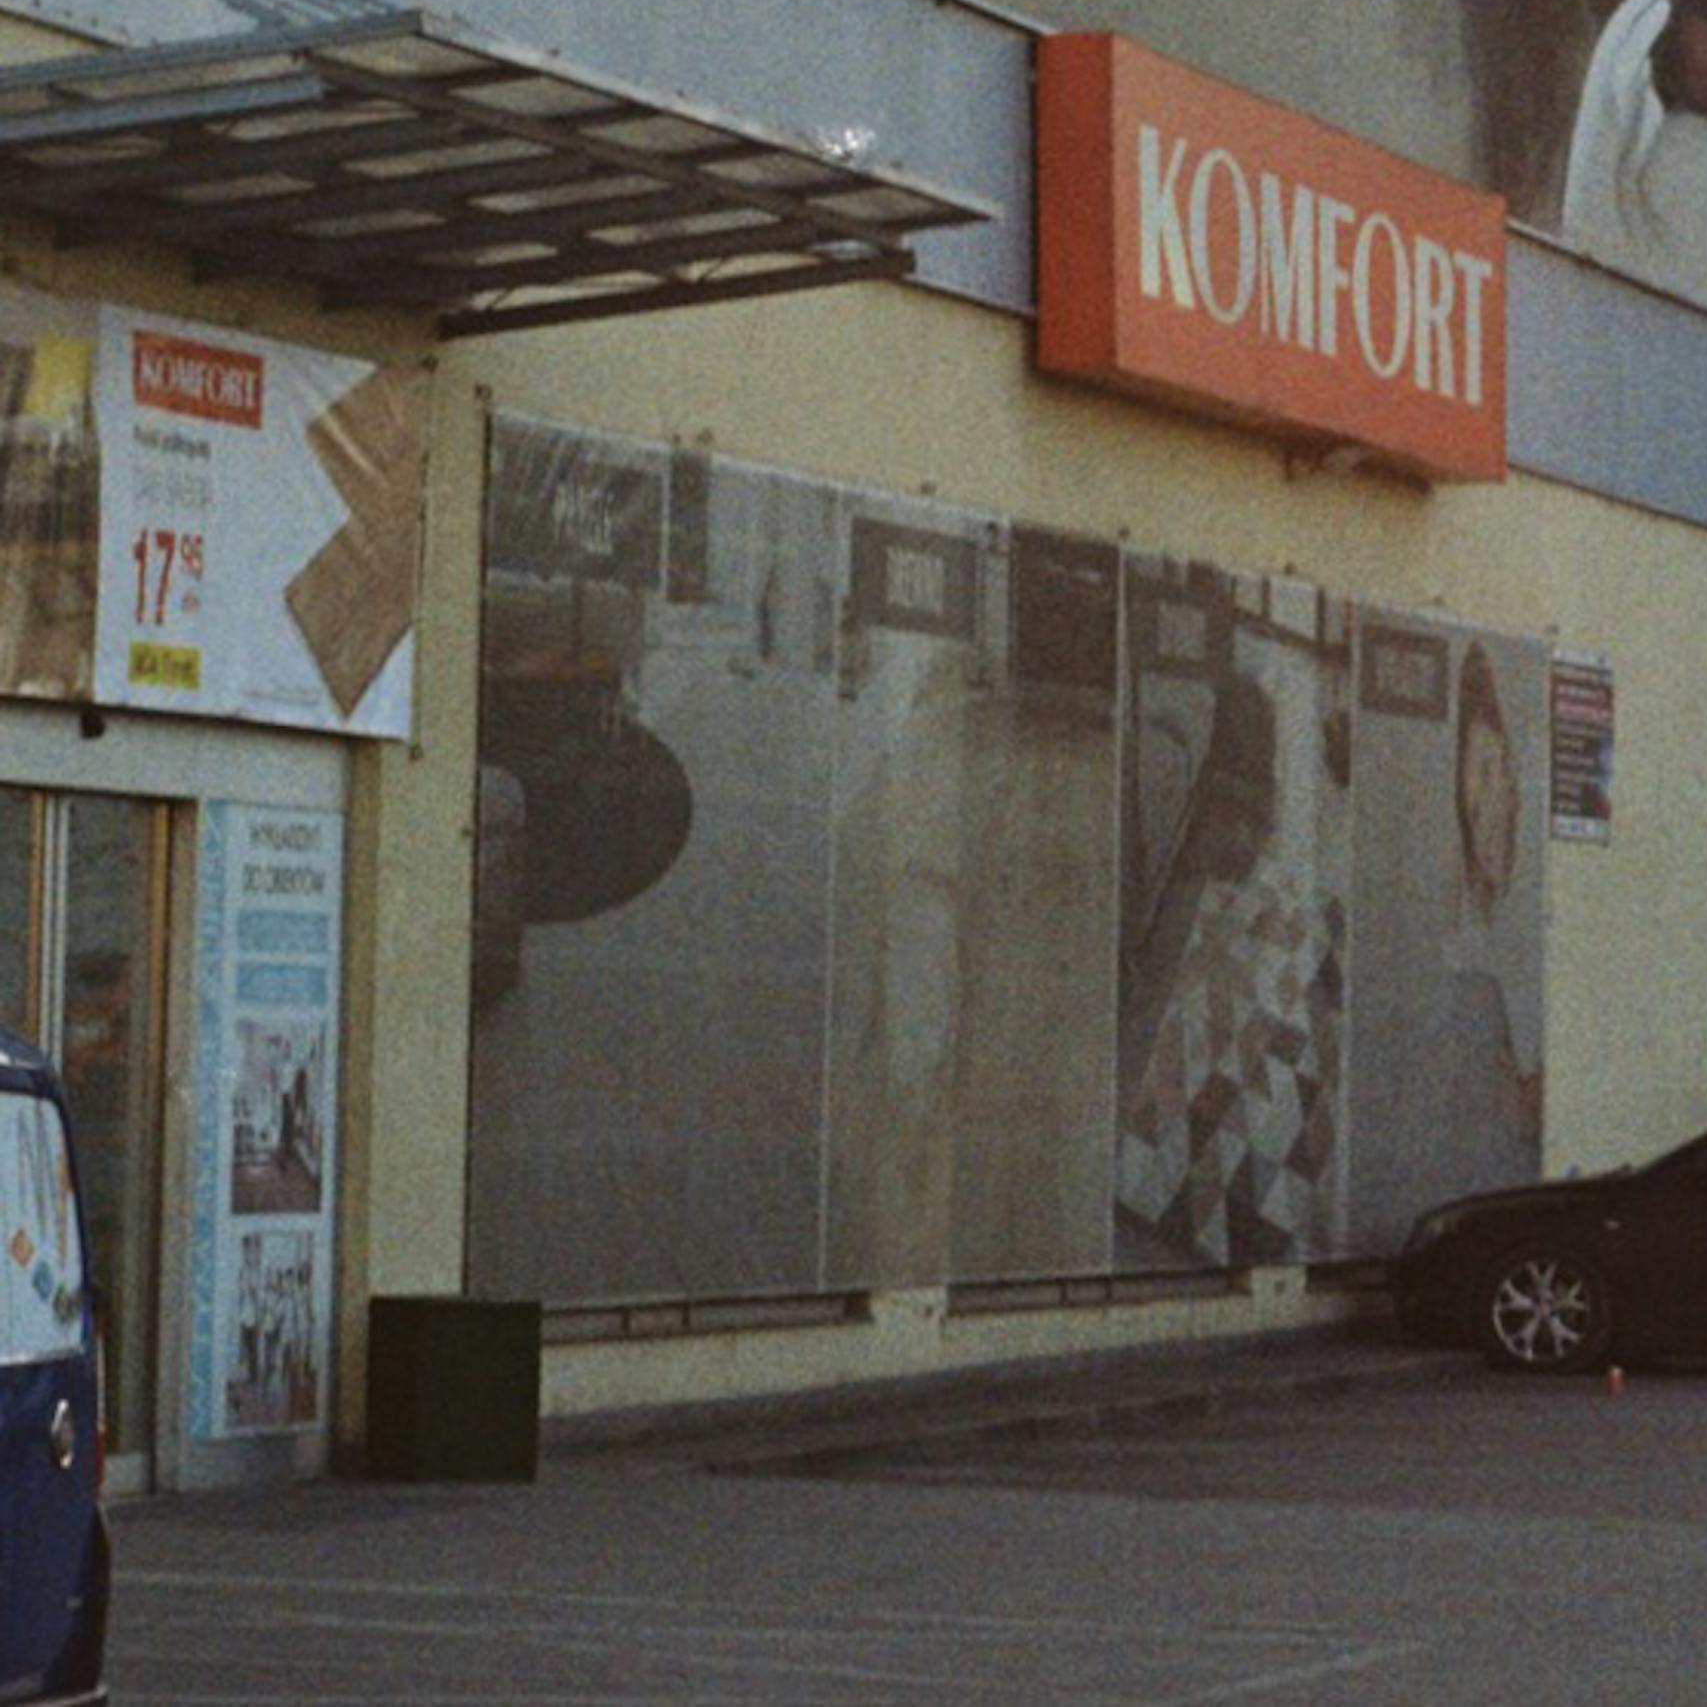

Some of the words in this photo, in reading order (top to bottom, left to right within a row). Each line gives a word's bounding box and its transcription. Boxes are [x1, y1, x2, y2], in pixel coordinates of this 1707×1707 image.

[1138, 123, 1493, 407] KOMFORT
[141, 348, 258, 410] KOMFORT
[133, 528, 176, 627] 17
